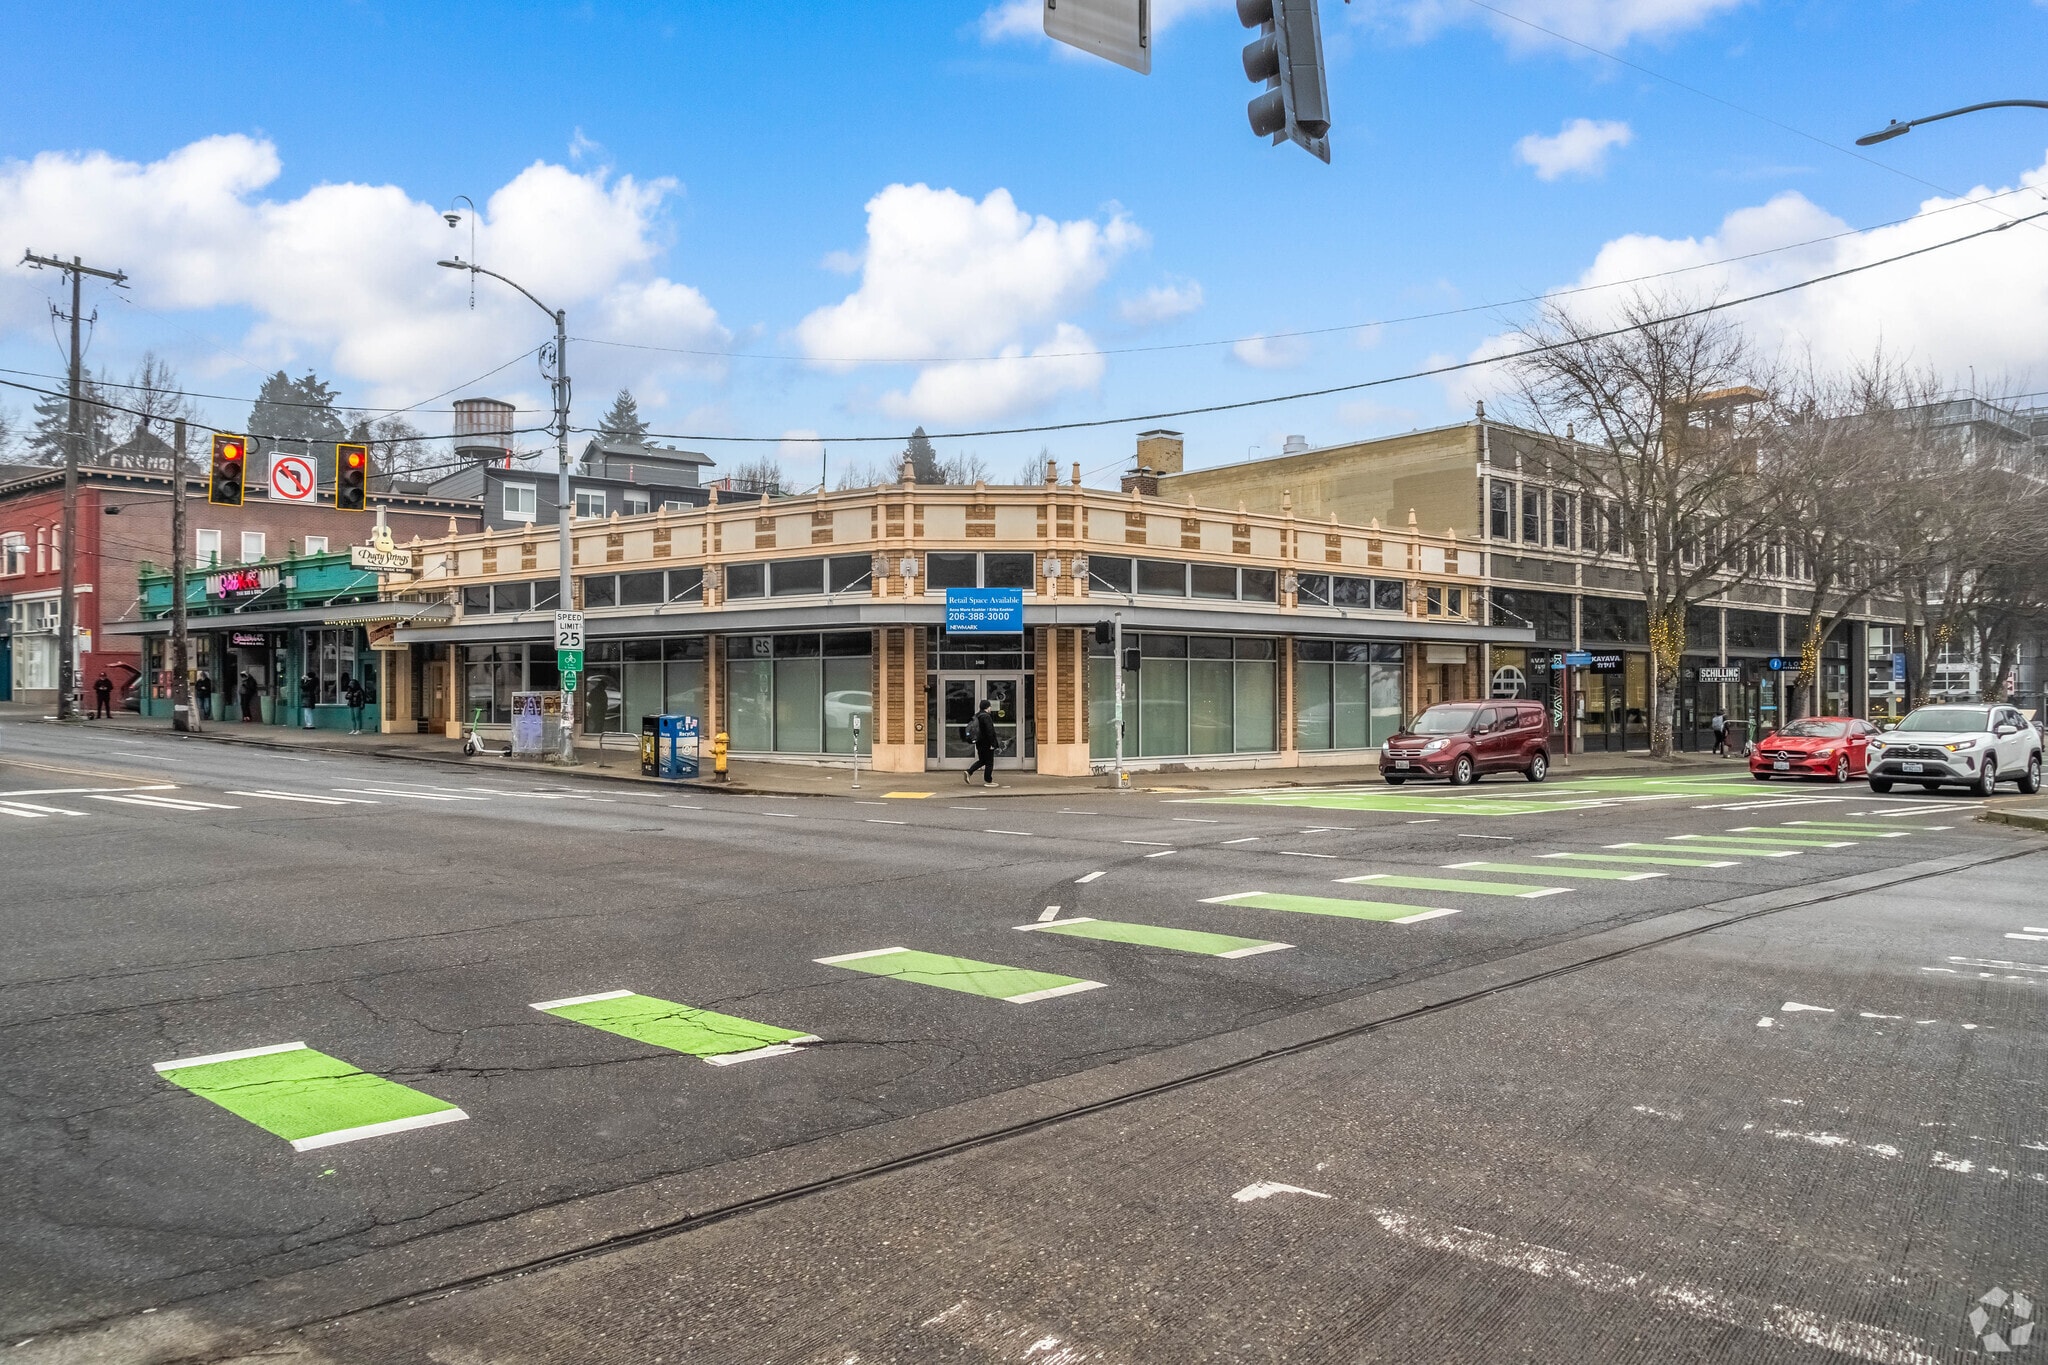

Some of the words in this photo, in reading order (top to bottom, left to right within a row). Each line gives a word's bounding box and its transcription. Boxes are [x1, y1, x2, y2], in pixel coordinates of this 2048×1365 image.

[386, 551, 409, 566] Strings
[969, 597, 988, 605] Space
[949, 613, 1010, 621] 206-388-3000
[560, 632, 580, 646] 25
[1701, 669, 1738, 678] SCHILLING
